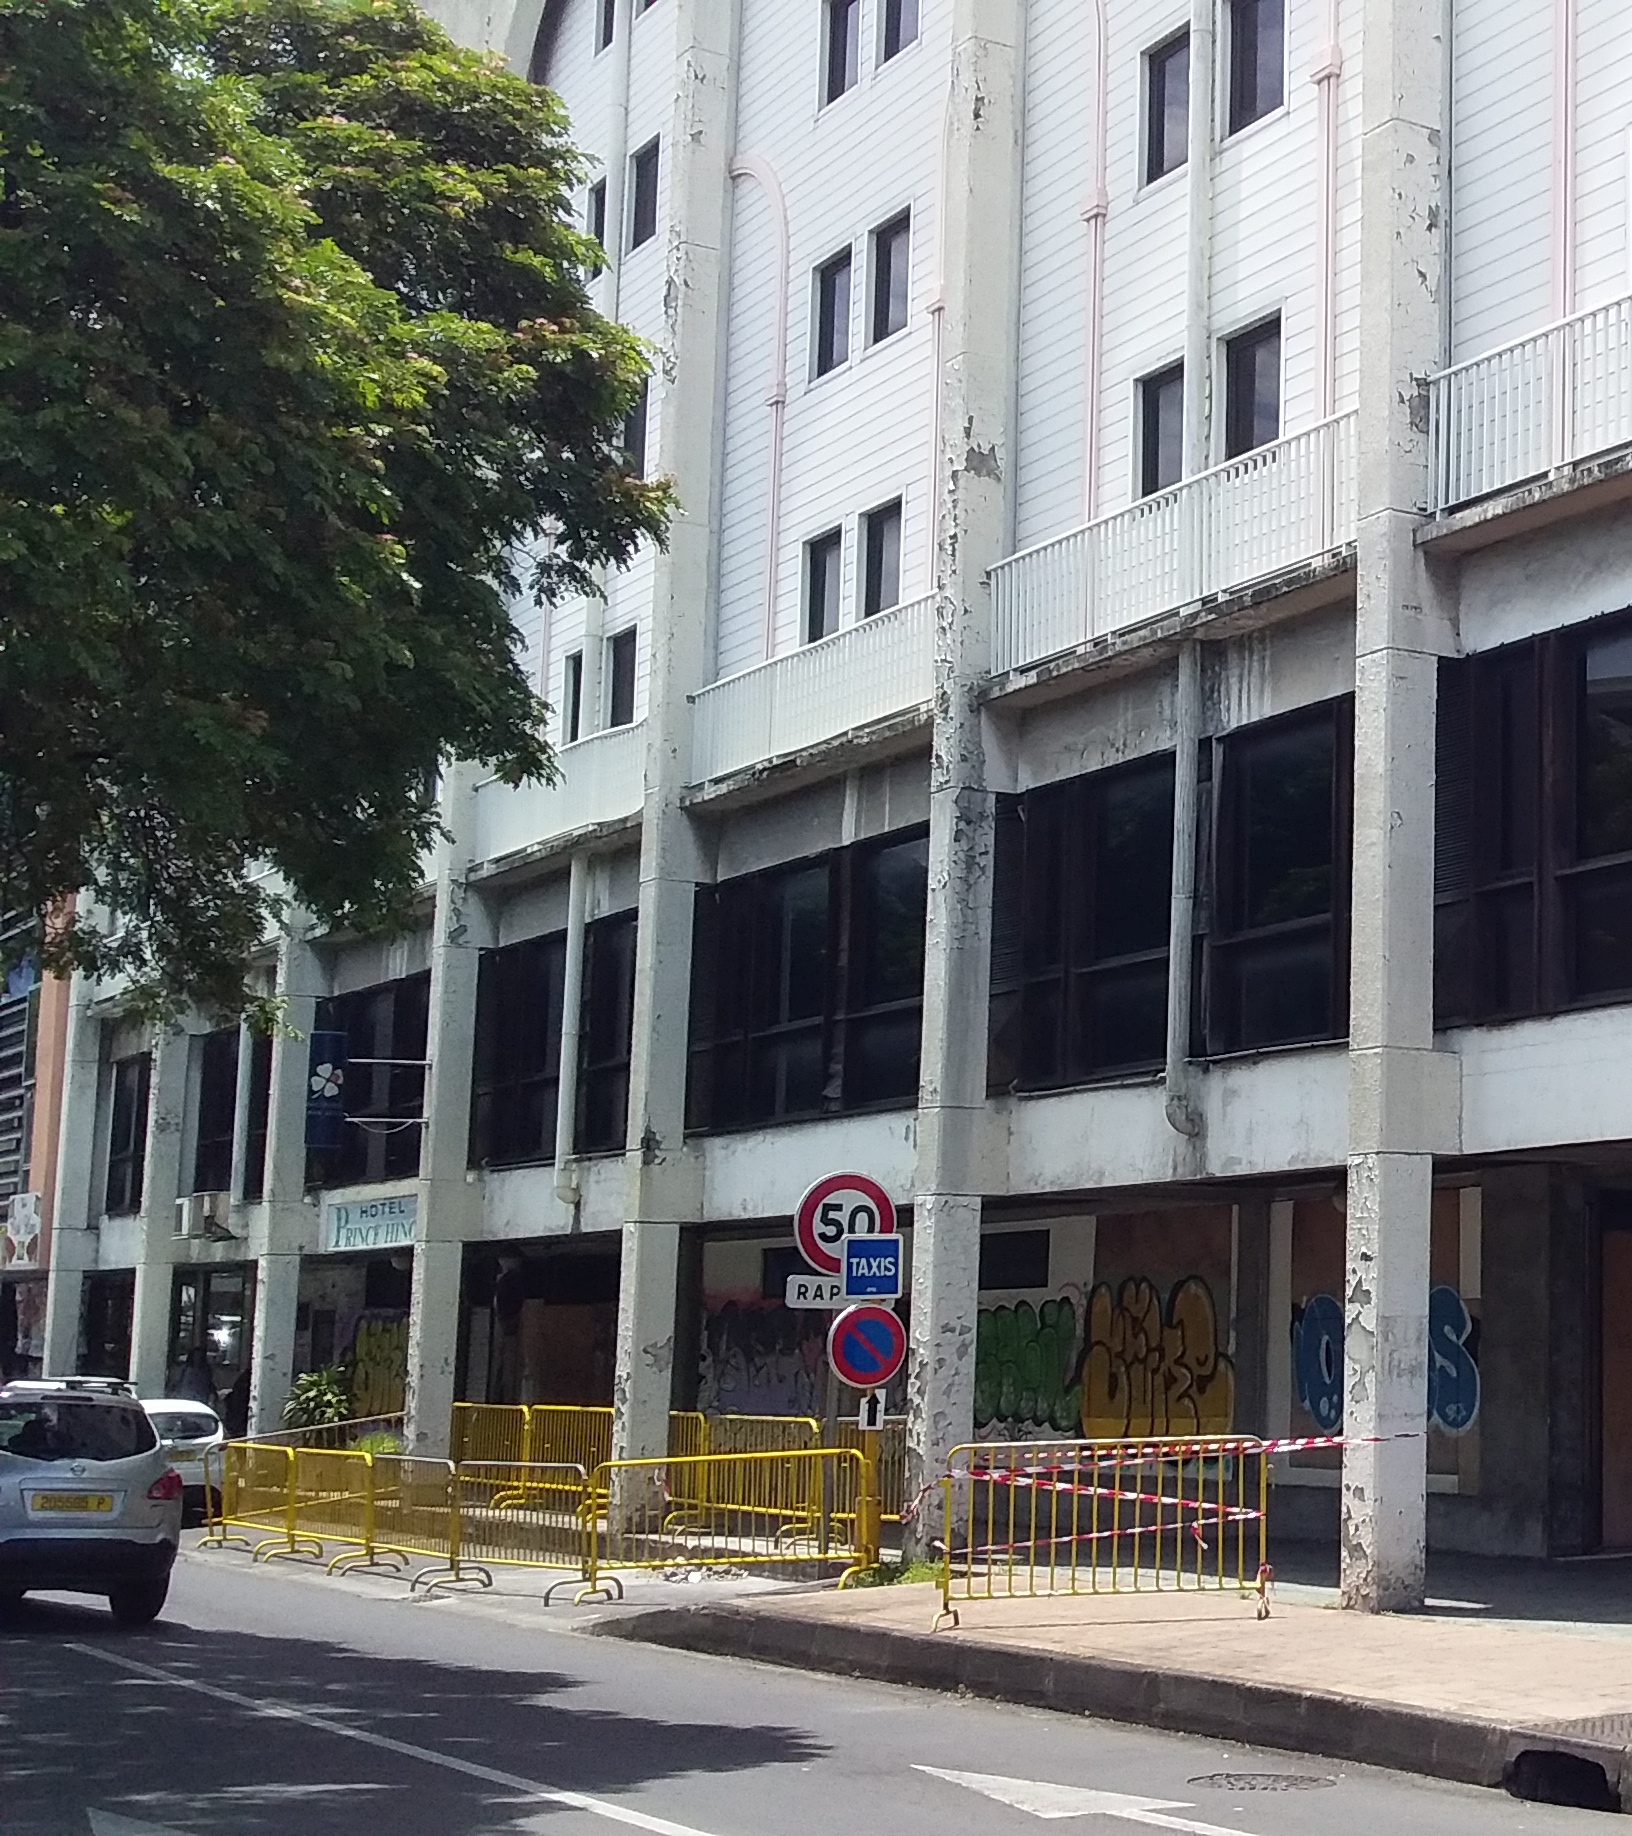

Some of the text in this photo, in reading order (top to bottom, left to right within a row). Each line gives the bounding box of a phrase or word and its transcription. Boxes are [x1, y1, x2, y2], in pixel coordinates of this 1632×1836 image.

[360, 1200, 405, 1219] HOTEL
[333, 1206, 381, 1248] PRINCE
[817, 1202, 876, 1244] 50
[849, 1257, 896, 1277] TAXIS
[796, 1283, 841, 1301] RAP
